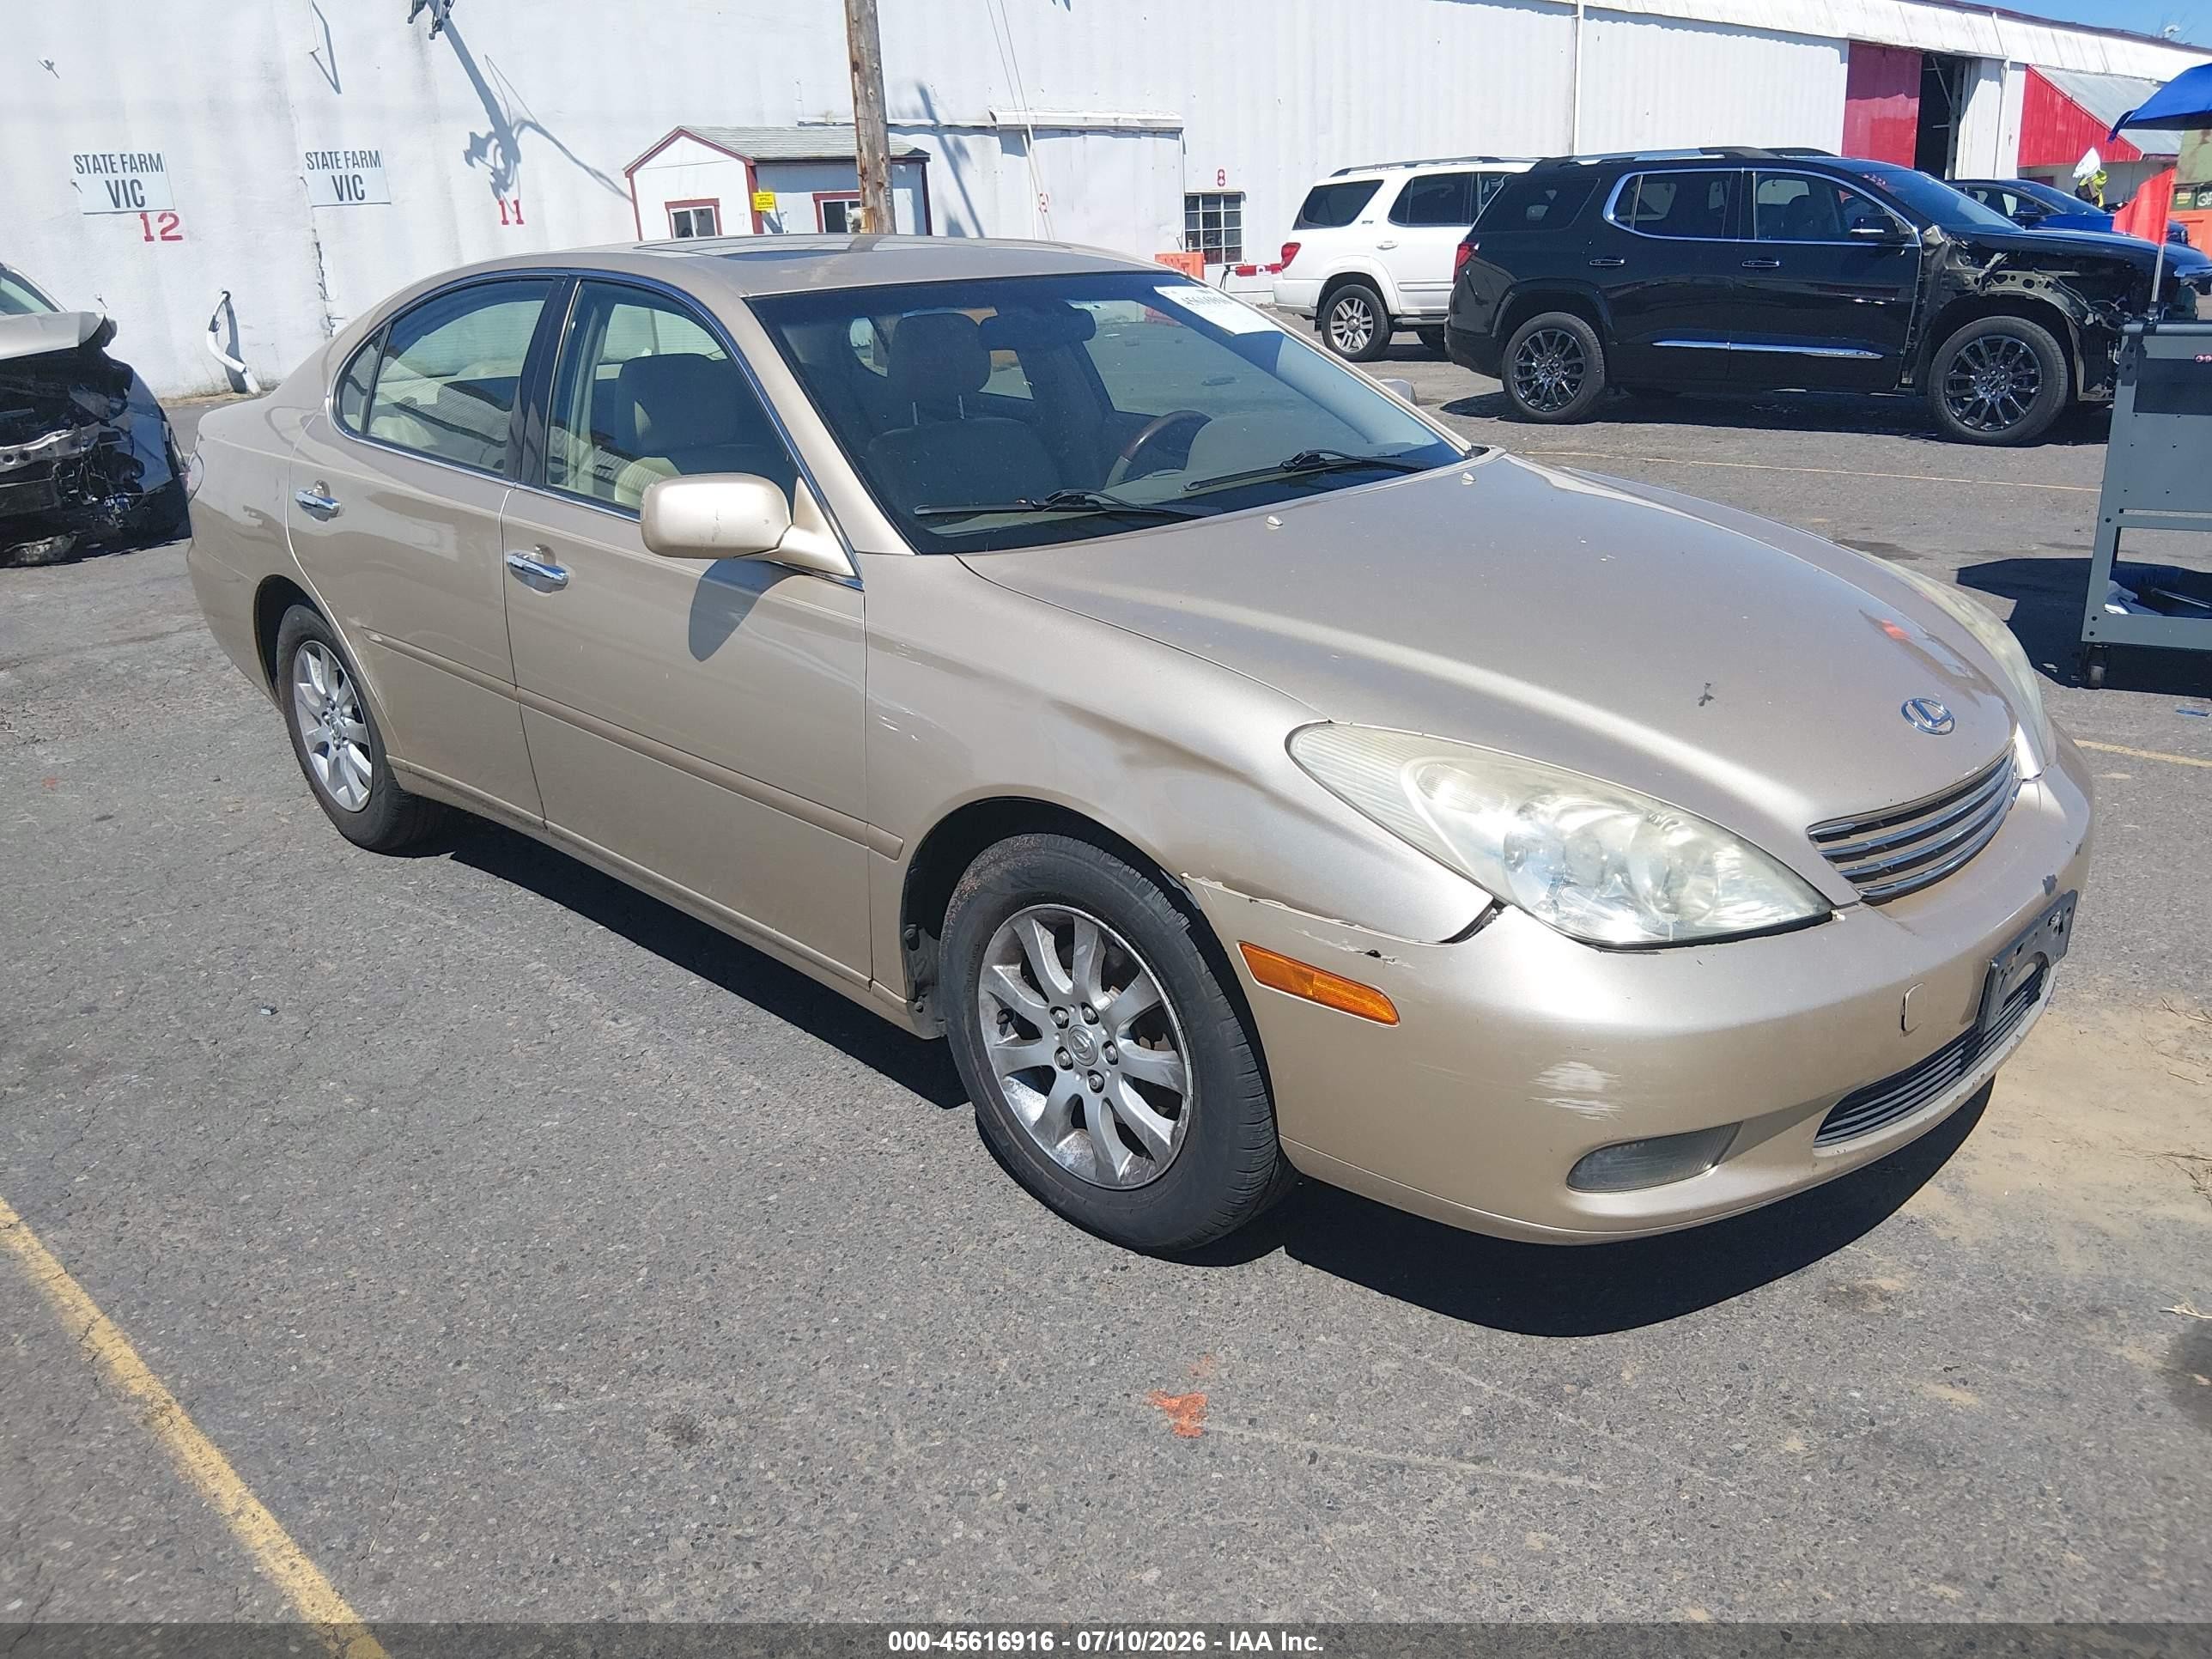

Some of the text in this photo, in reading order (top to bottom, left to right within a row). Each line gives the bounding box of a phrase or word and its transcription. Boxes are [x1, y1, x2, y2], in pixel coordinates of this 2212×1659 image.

[73, 153, 164, 174] STATE FARM
[305, 149, 382, 170] STATE FARM
[331, 173, 366, 202] VIC
[1217, 168, 1225, 187] 8
[104, 179, 146, 209] VIC
[498, 199, 525, 225] 11
[139, 212, 184, 242] 12
